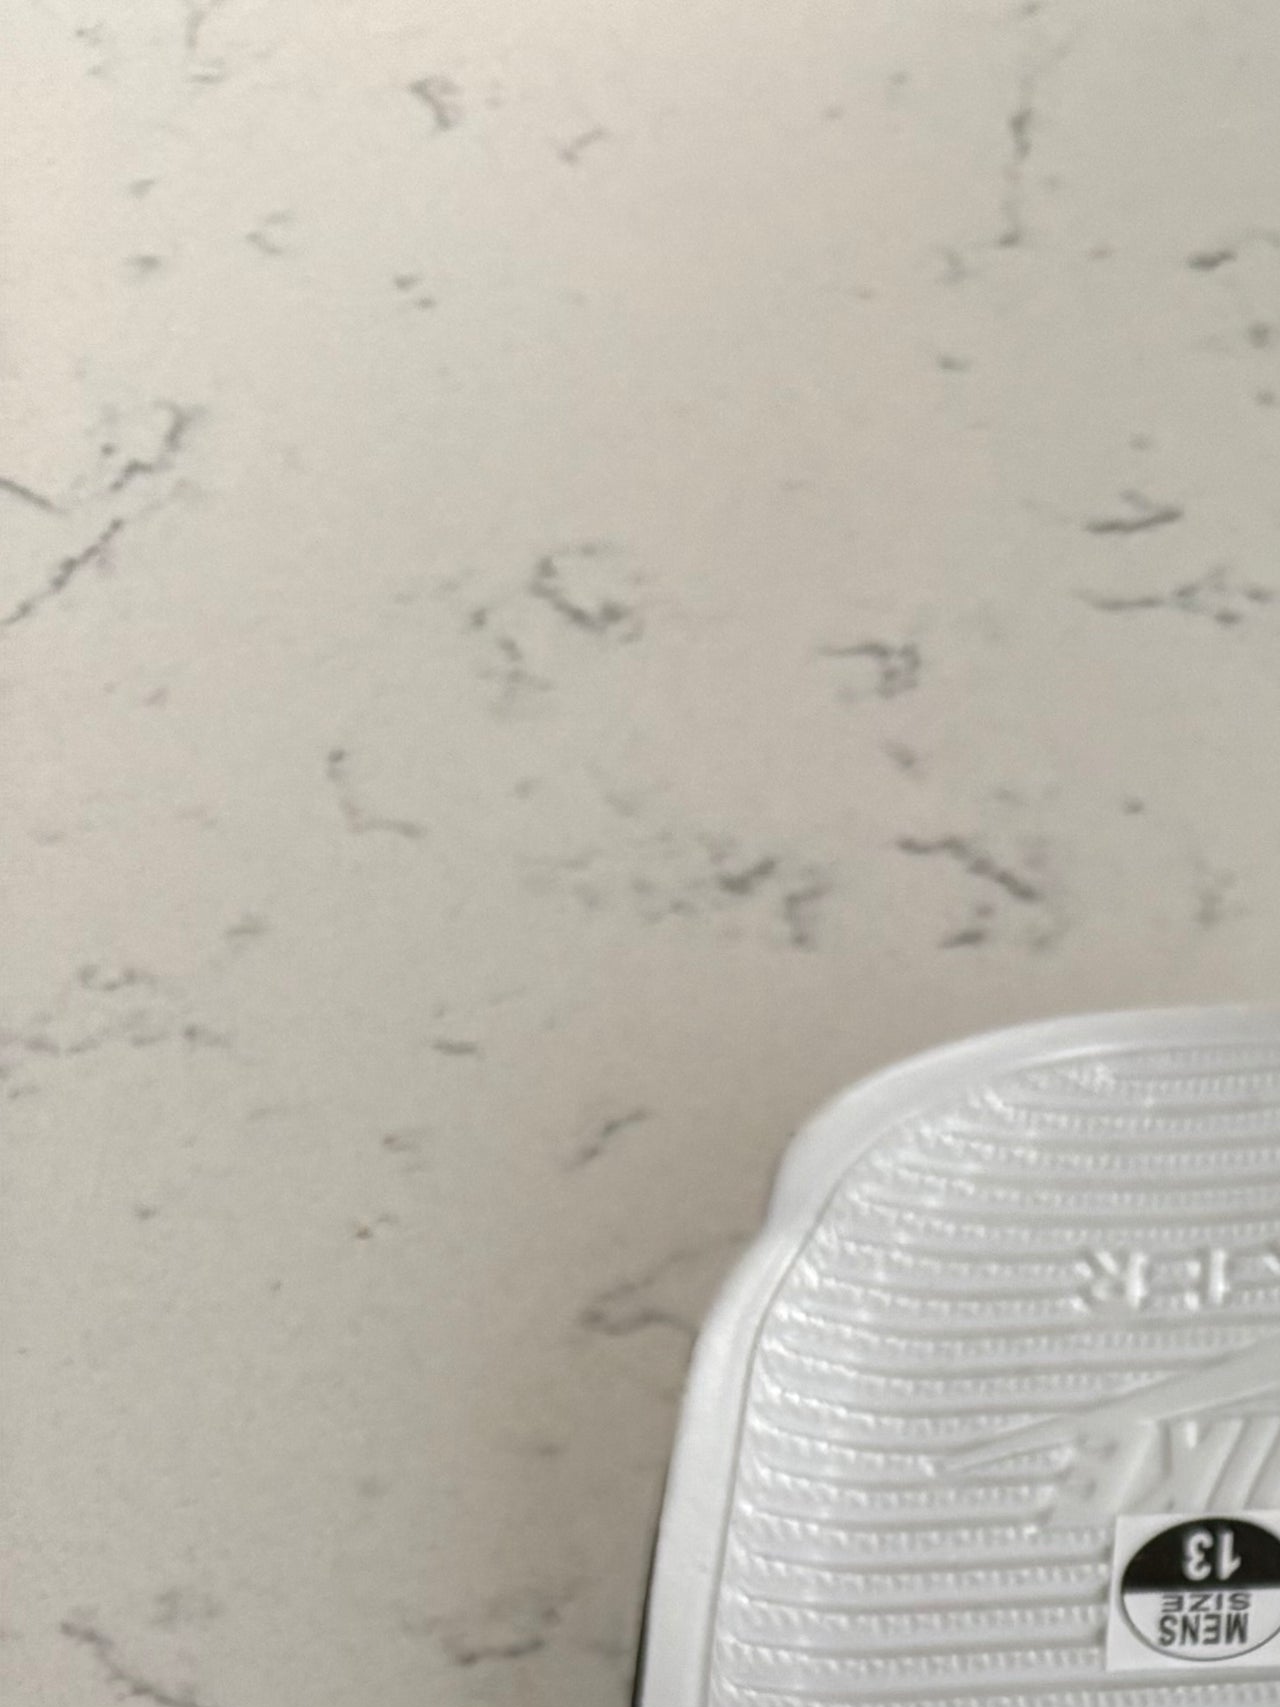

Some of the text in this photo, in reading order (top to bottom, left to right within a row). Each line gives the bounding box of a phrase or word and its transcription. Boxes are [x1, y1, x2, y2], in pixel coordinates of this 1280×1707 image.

[1183, 1528, 1243, 1581] 13
[1161, 1591, 1252, 1613] SIZE
[1158, 1613, 1249, 1647] MENS
